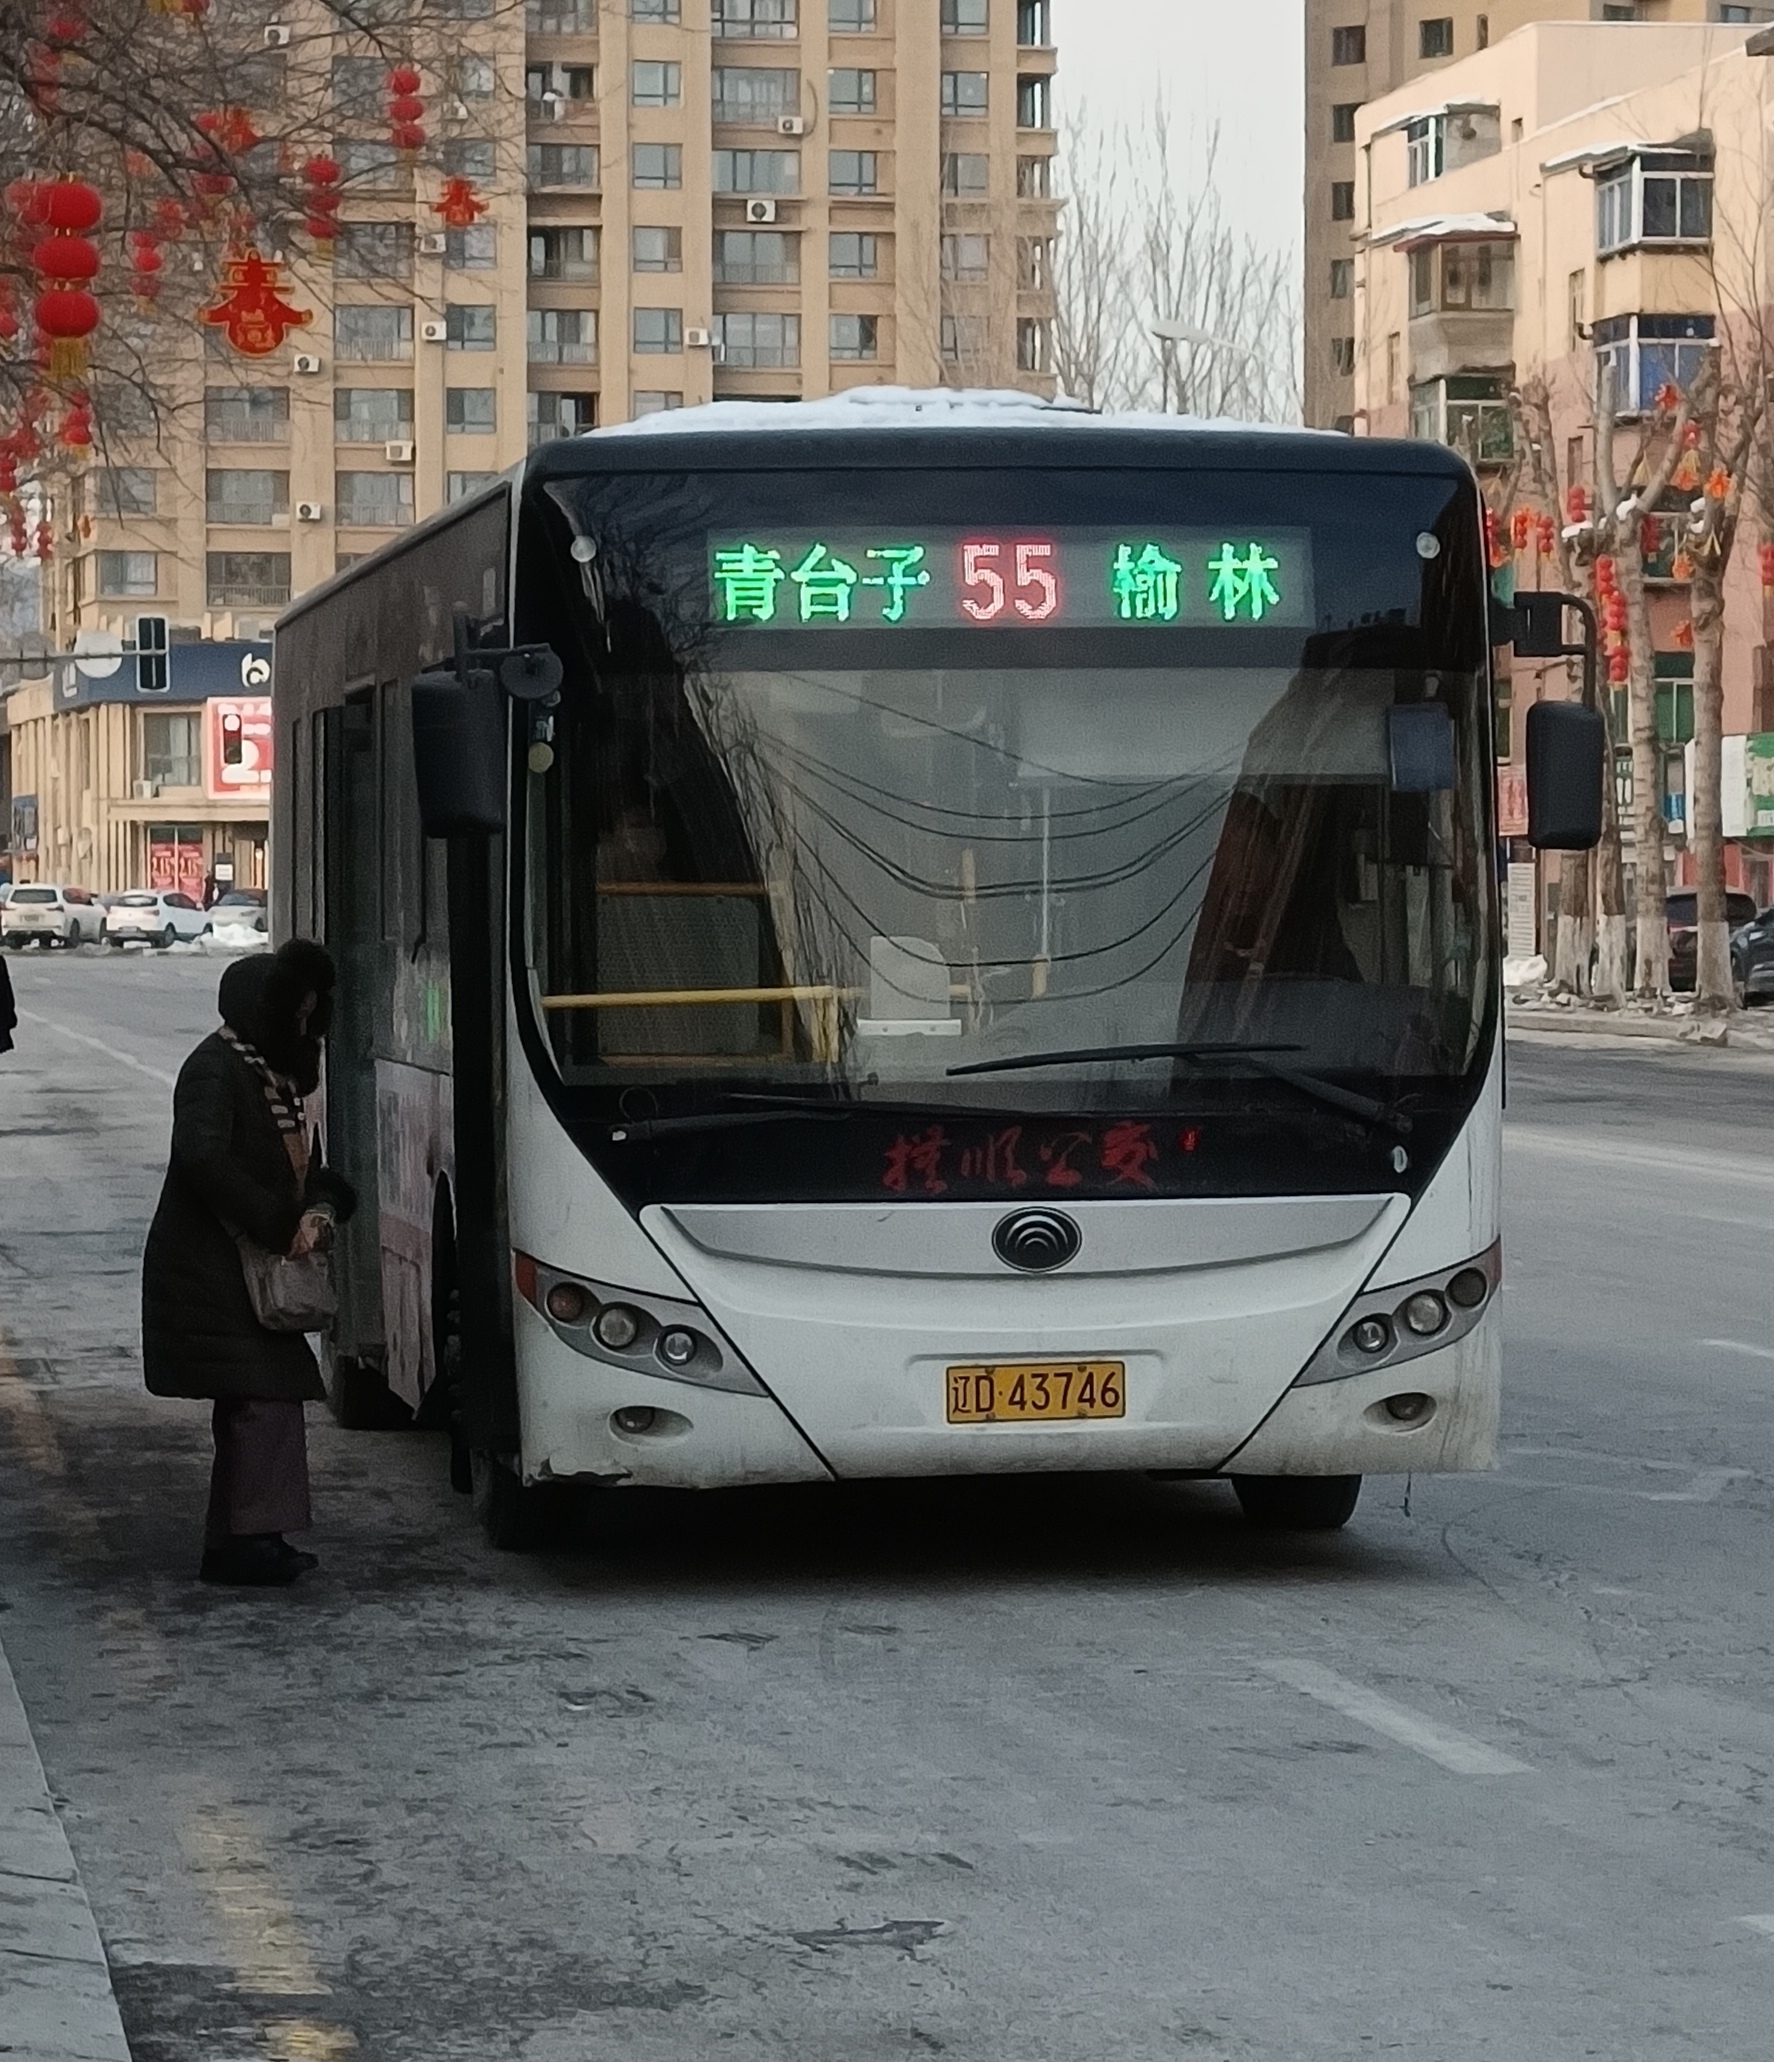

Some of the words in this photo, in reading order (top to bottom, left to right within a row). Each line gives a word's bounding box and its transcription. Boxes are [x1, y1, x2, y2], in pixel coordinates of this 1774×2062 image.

[714, 543, 929, 622] 青台子
[960, 543, 1059, 619] 55
